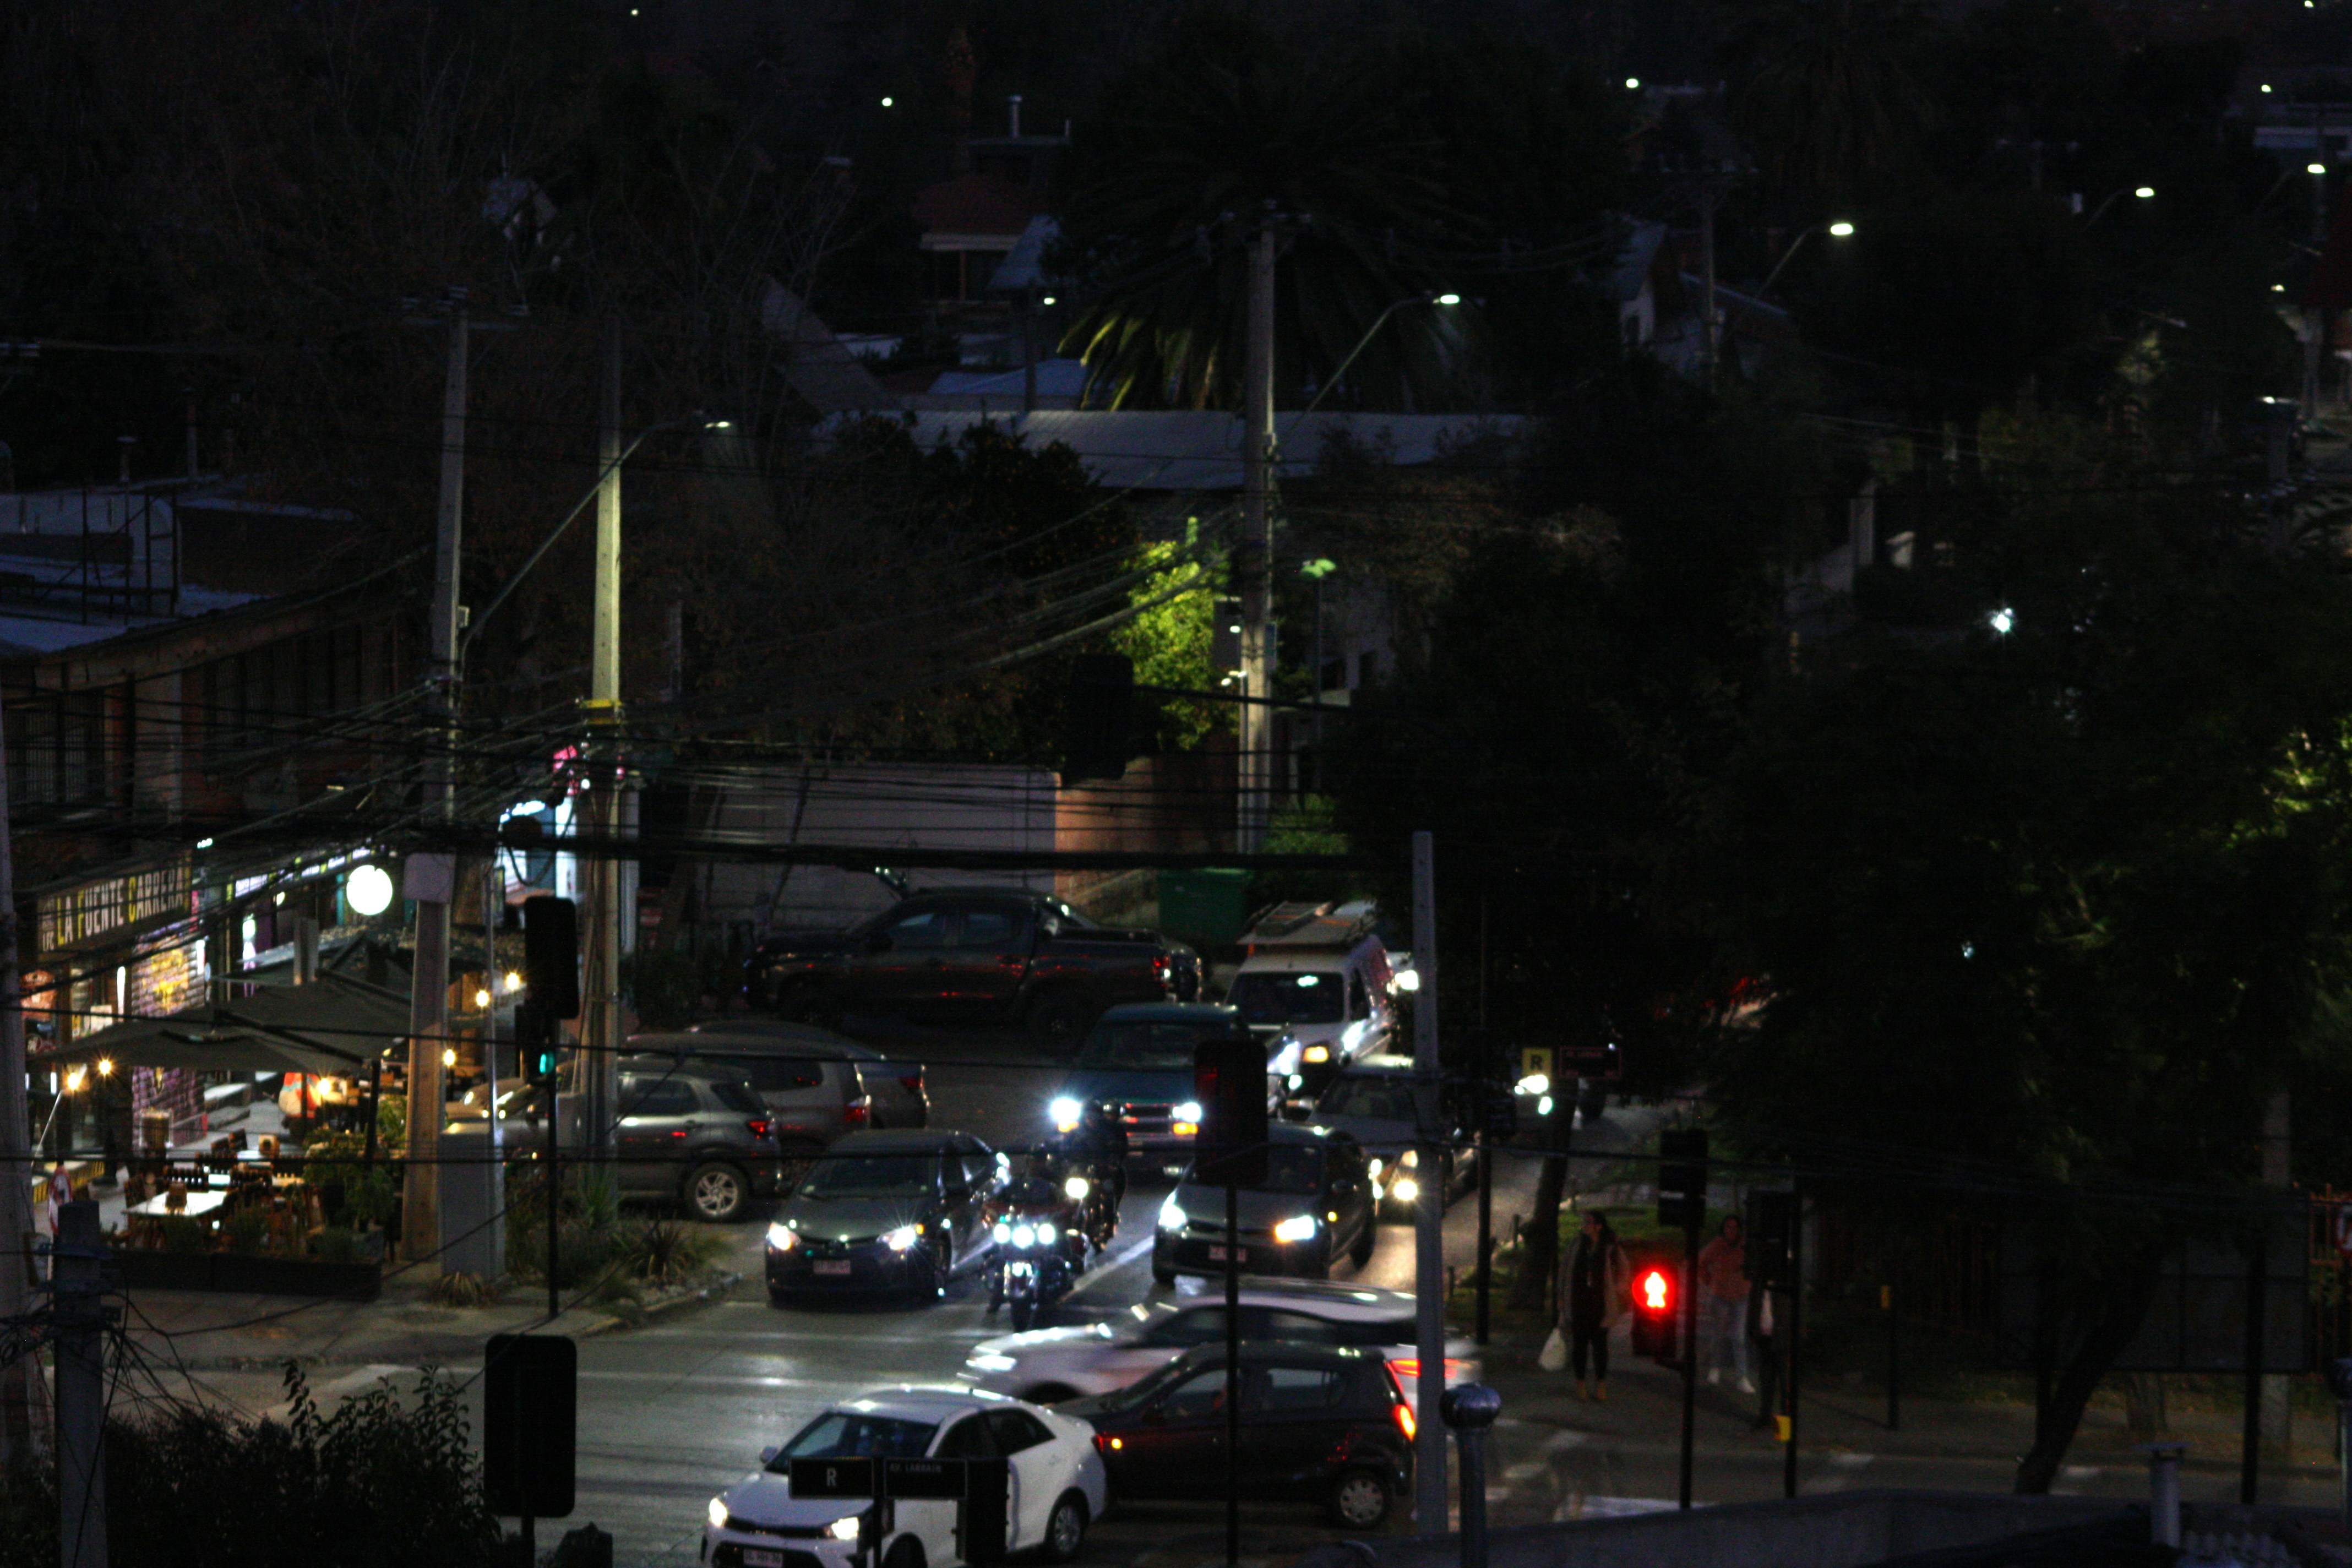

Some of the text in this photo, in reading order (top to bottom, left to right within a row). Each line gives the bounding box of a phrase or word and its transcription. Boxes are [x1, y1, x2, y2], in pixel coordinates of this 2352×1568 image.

[57, 895, 74, 946] LA
[77, 878, 124, 939] FUENTE
[128, 867, 183, 924] CARRERA
[826, 1466, 837, 1487] R
